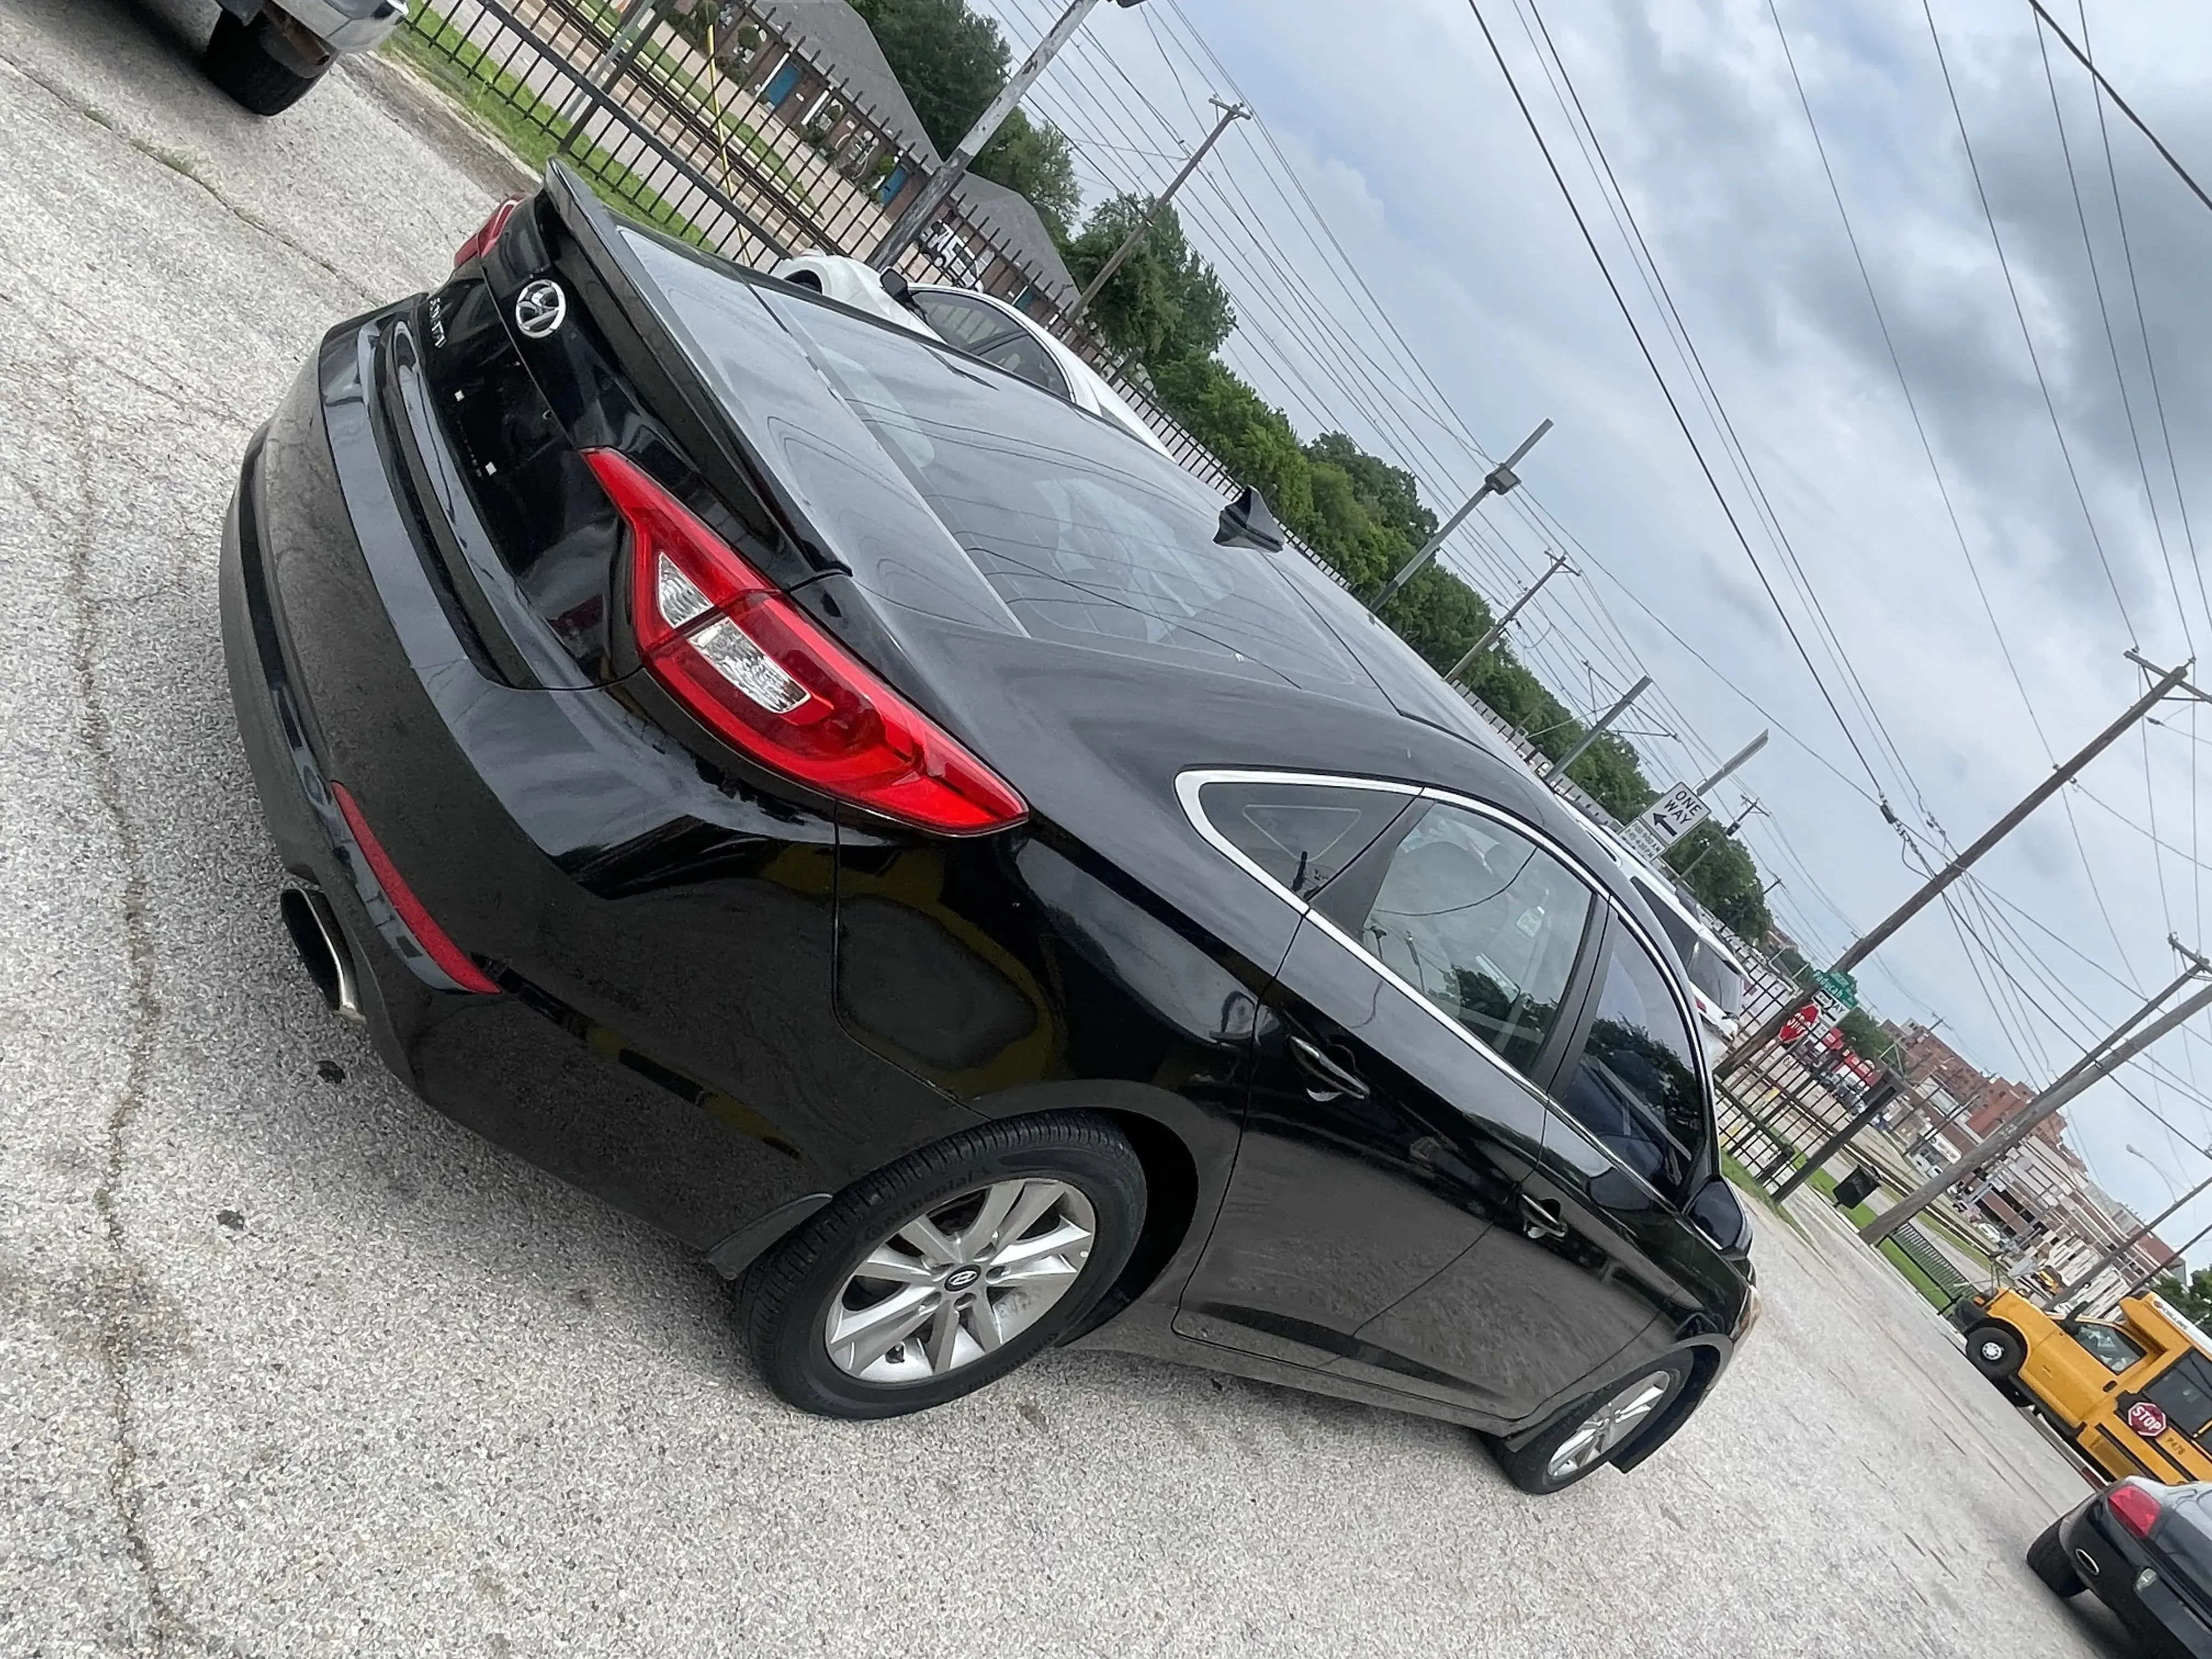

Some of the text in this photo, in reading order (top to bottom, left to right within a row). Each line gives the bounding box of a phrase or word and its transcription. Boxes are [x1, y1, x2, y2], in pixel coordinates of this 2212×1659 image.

[1663, 799, 1692, 824] WAY
[1675, 791, 1702, 816] ONE
[2132, 1406, 2162, 1430] STOP
